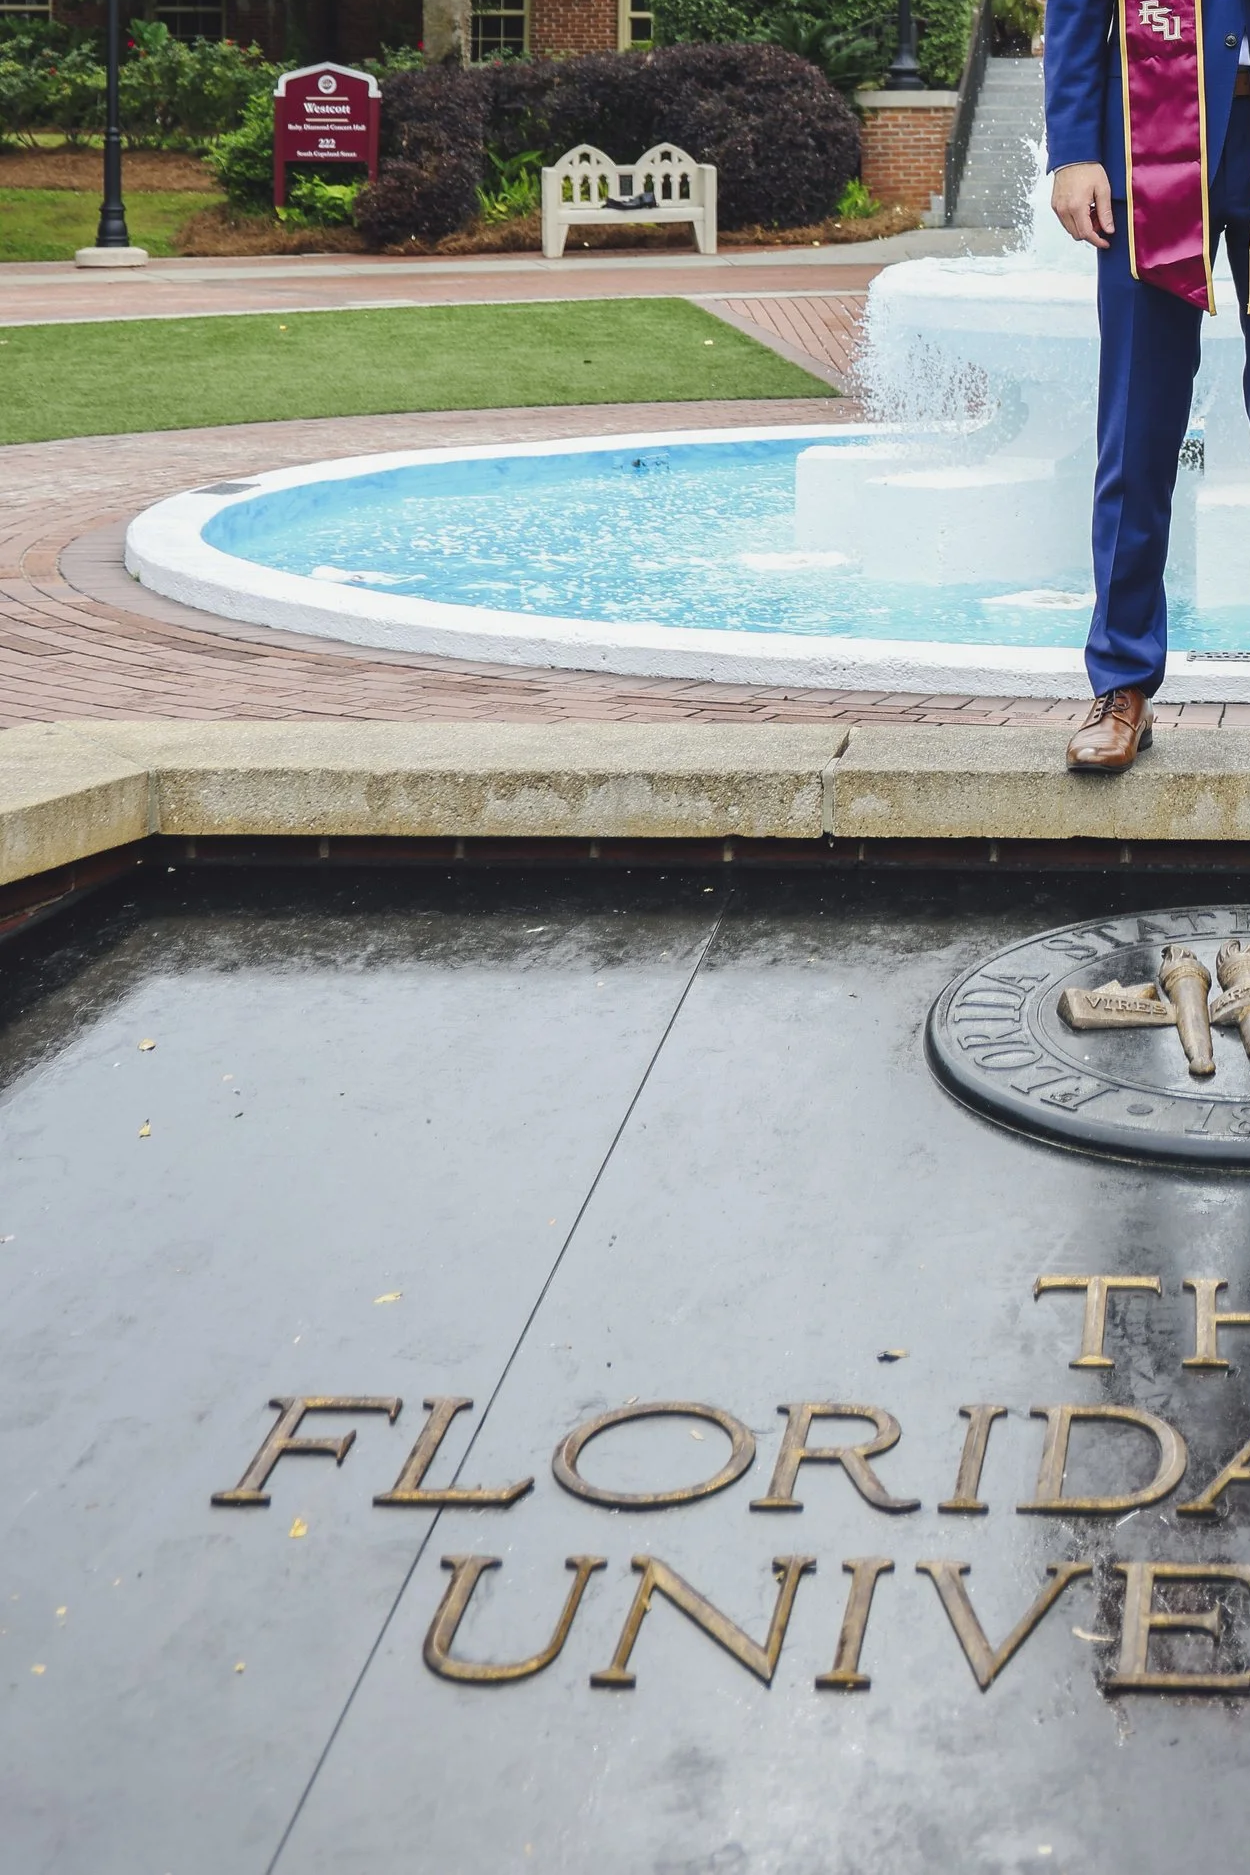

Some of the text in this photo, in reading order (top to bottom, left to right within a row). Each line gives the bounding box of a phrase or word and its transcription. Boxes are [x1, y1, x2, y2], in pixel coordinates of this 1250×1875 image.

[1138, 0, 1182, 41] FSU
[303, 102, 351, 114] Westcott
[303, 123, 330, 131] Diamond
[318, 138, 336, 148] 222
[1084, 994, 1169, 1016] VIRES
[954, 973, 1120, 1111] FLORIDA
